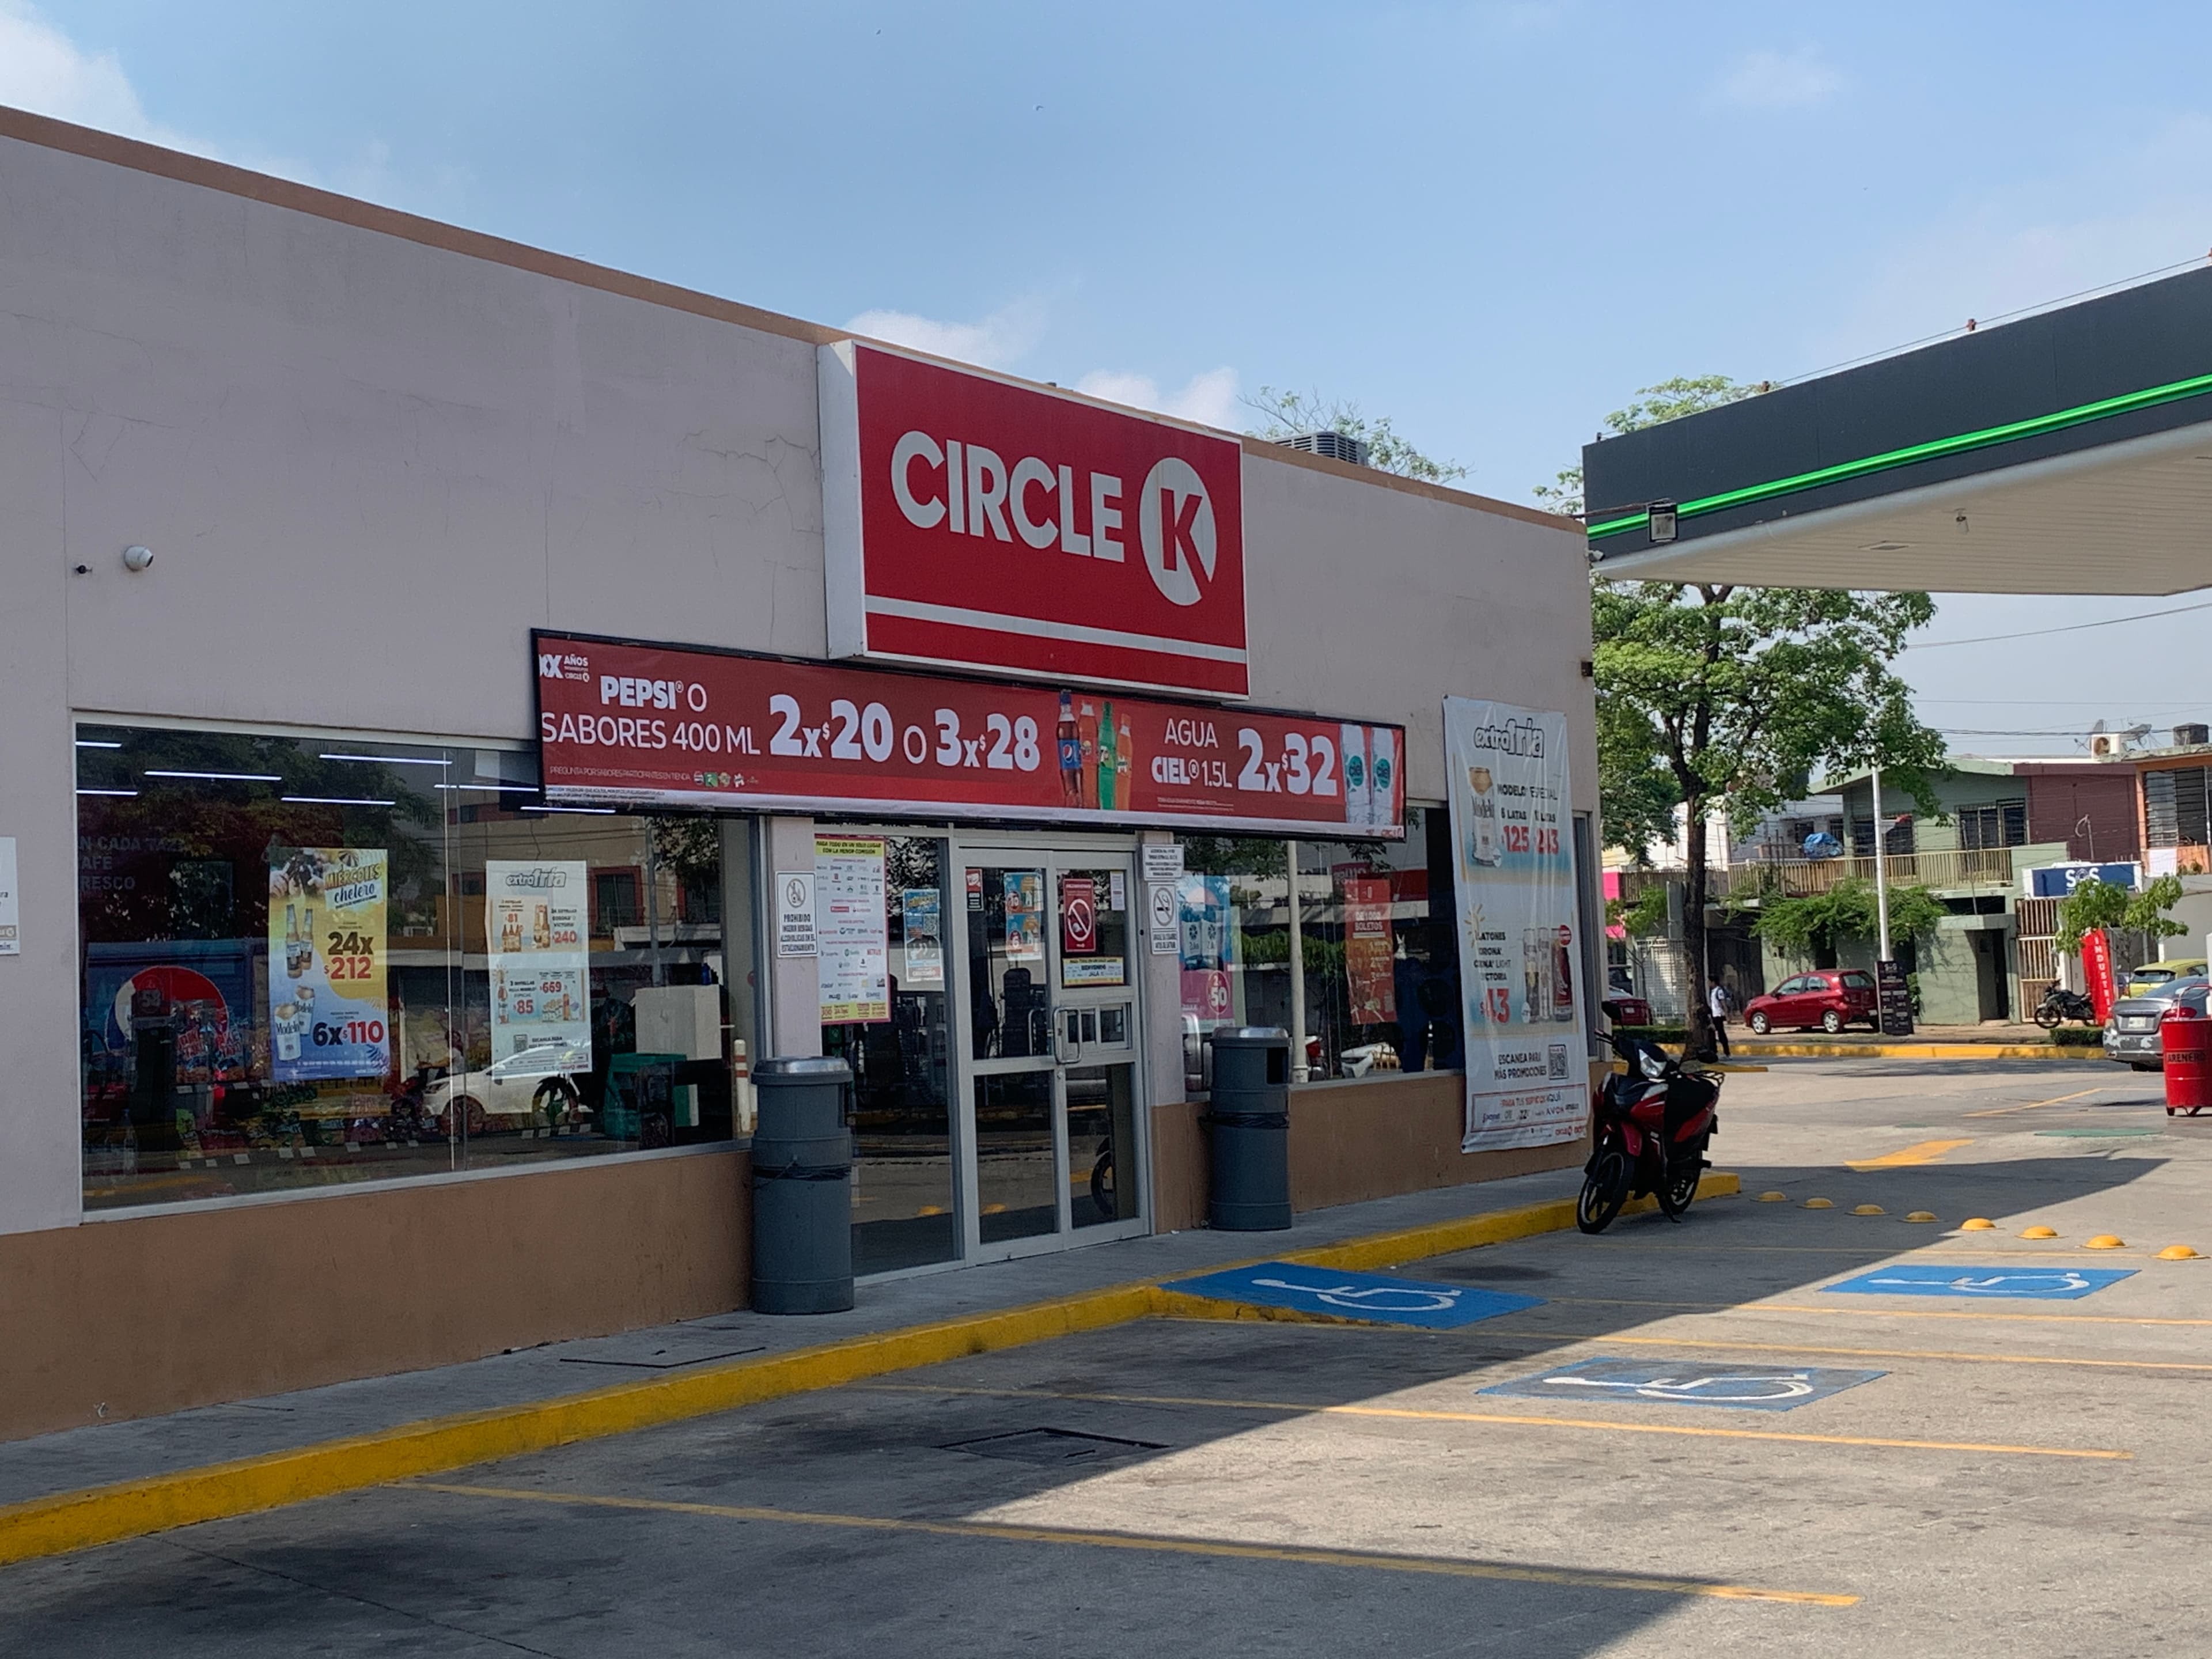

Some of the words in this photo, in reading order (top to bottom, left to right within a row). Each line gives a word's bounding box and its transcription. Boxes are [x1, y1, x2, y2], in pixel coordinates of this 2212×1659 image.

[891, 430, 1125, 563] CIRCLE
[564, 653, 588, 667] AÑOS
[687, 683, 707, 713] O
[541, 712, 667, 751] SABORES
[672, 722, 721, 753] 400
[726, 725, 760, 756] ML
[903, 725, 927, 764] O
[1164, 718, 1218, 750] AGUA
[1201, 760, 1233, 789] 1.5L
[334, 884, 374, 904] chelero
[327, 931, 374, 956] 24x
[324, 956, 372, 980] $212
[1498, 1052, 1528, 1065] ESCANEA
